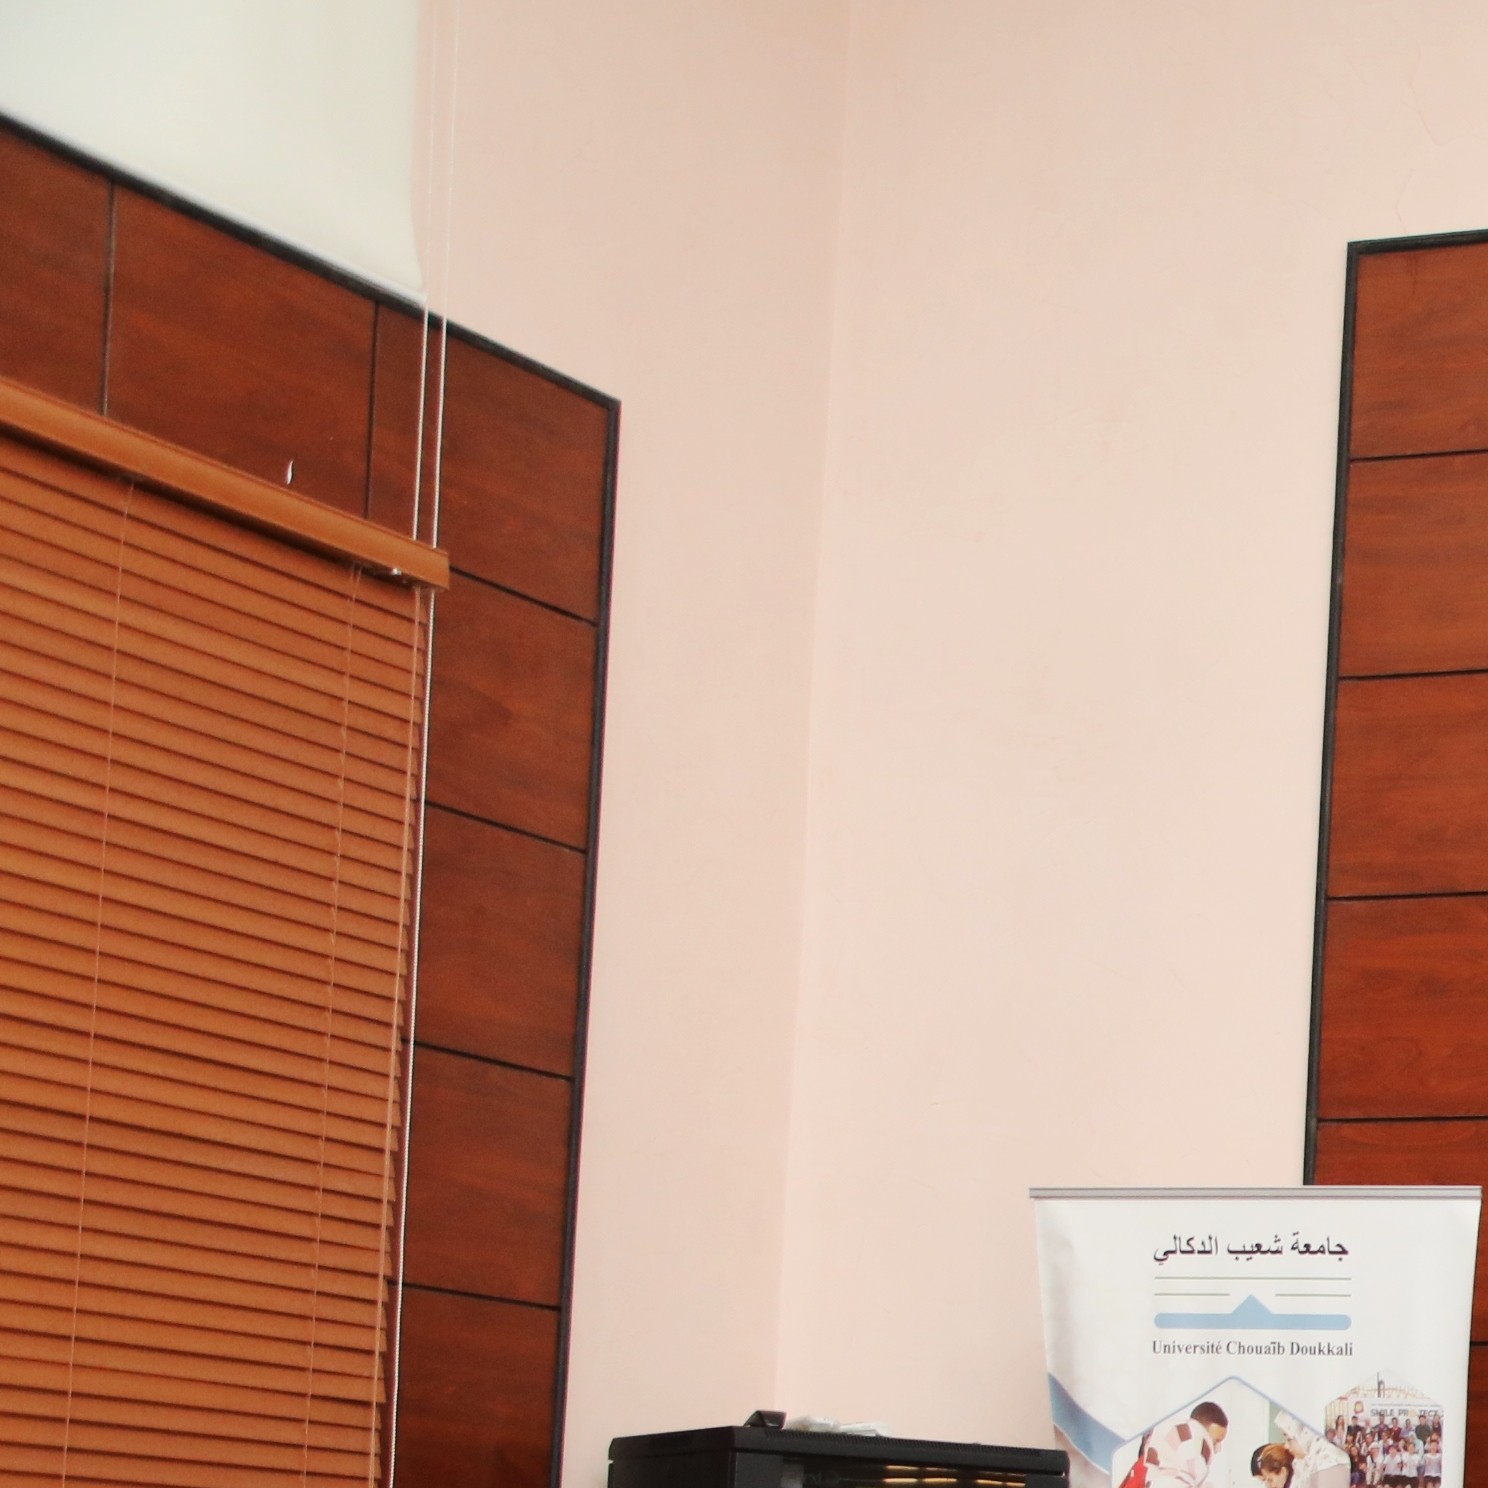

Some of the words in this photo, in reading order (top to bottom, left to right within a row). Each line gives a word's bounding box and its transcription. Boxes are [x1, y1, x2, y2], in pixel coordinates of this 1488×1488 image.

[1153, 1235, 1219, 1266] الدكالي
[1226, 1234, 1284, 1262] شعيب
[1290, 1231, 1349, 1262] جامعة
[1152, 1340, 1222, 1355] Université
[1226, 1340, 1285, 1356] Chouaïb
[1290, 1341, 1353, 1357] Doukkali
